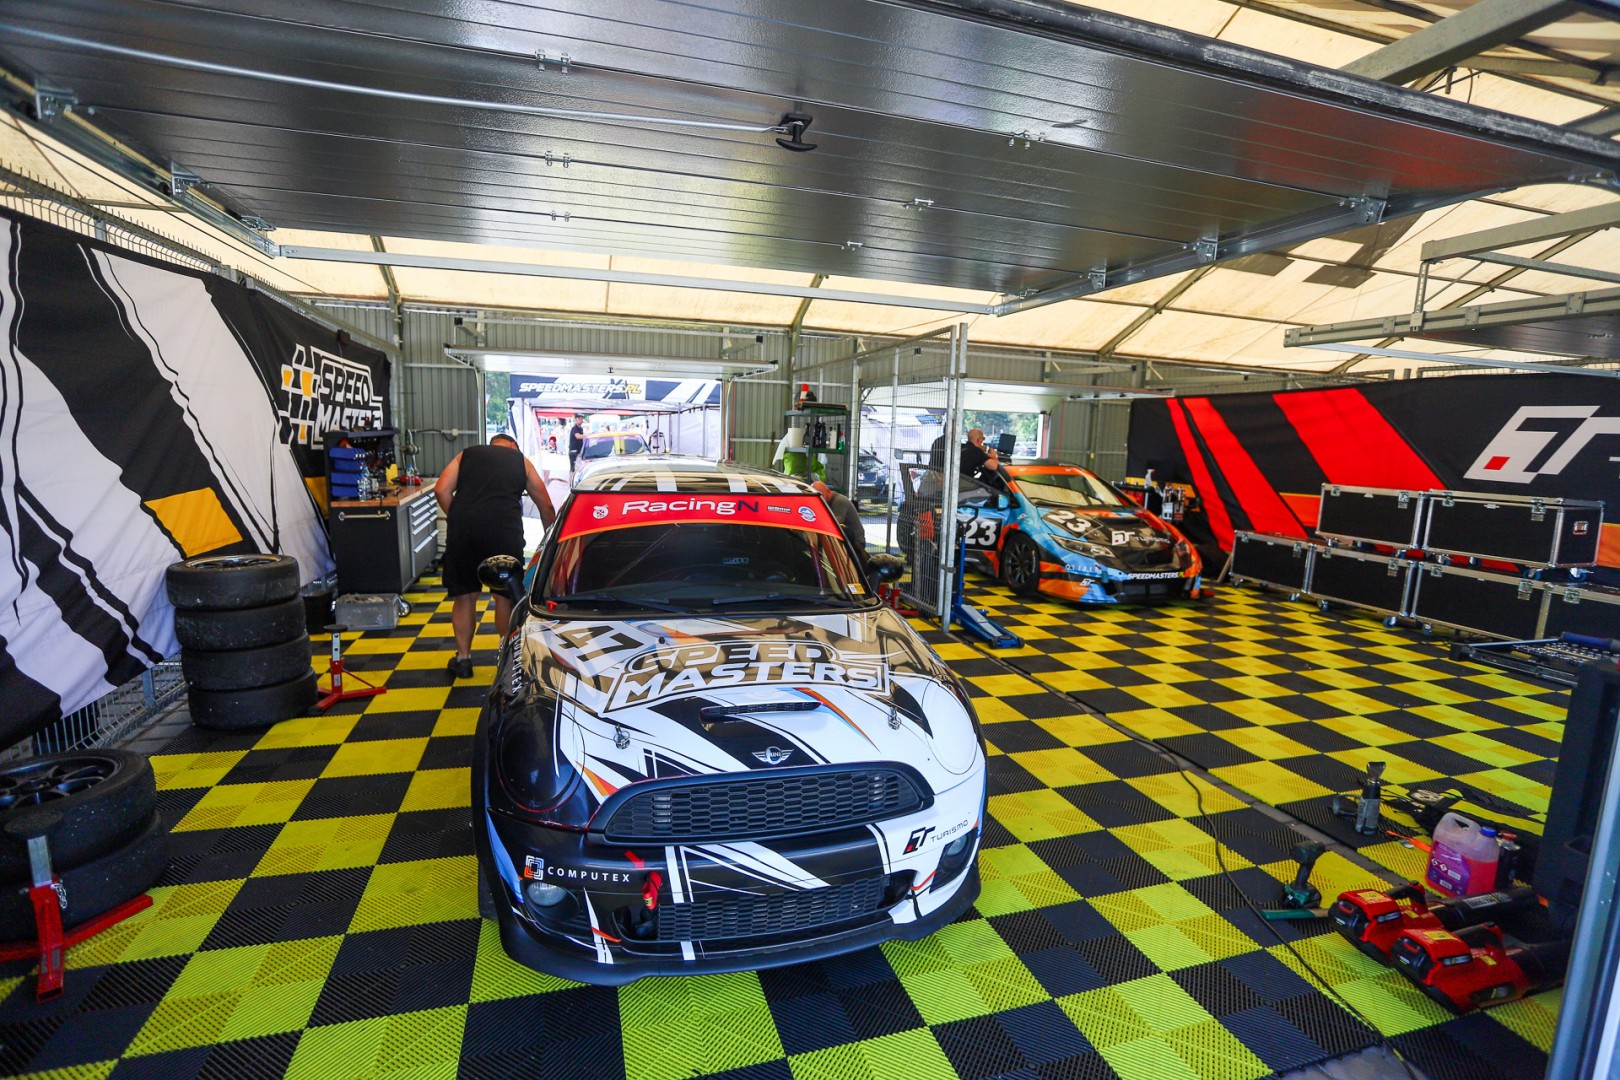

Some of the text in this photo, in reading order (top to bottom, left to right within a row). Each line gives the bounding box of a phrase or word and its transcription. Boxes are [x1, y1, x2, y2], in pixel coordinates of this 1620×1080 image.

[321, 361, 370, 406] SPEED
[519, 382, 642, 395] SPEEDMASTERS.PL
[960, 520, 997, 546] 23
[1048, 510, 1092, 533] 23
[557, 625, 645, 663] 47
[627, 642, 834, 674] SPEED
[621, 660, 881, 705] MASTERS
[930, 819, 969, 843] TURISMO
[547, 866, 630, 883] COMPUTEX
